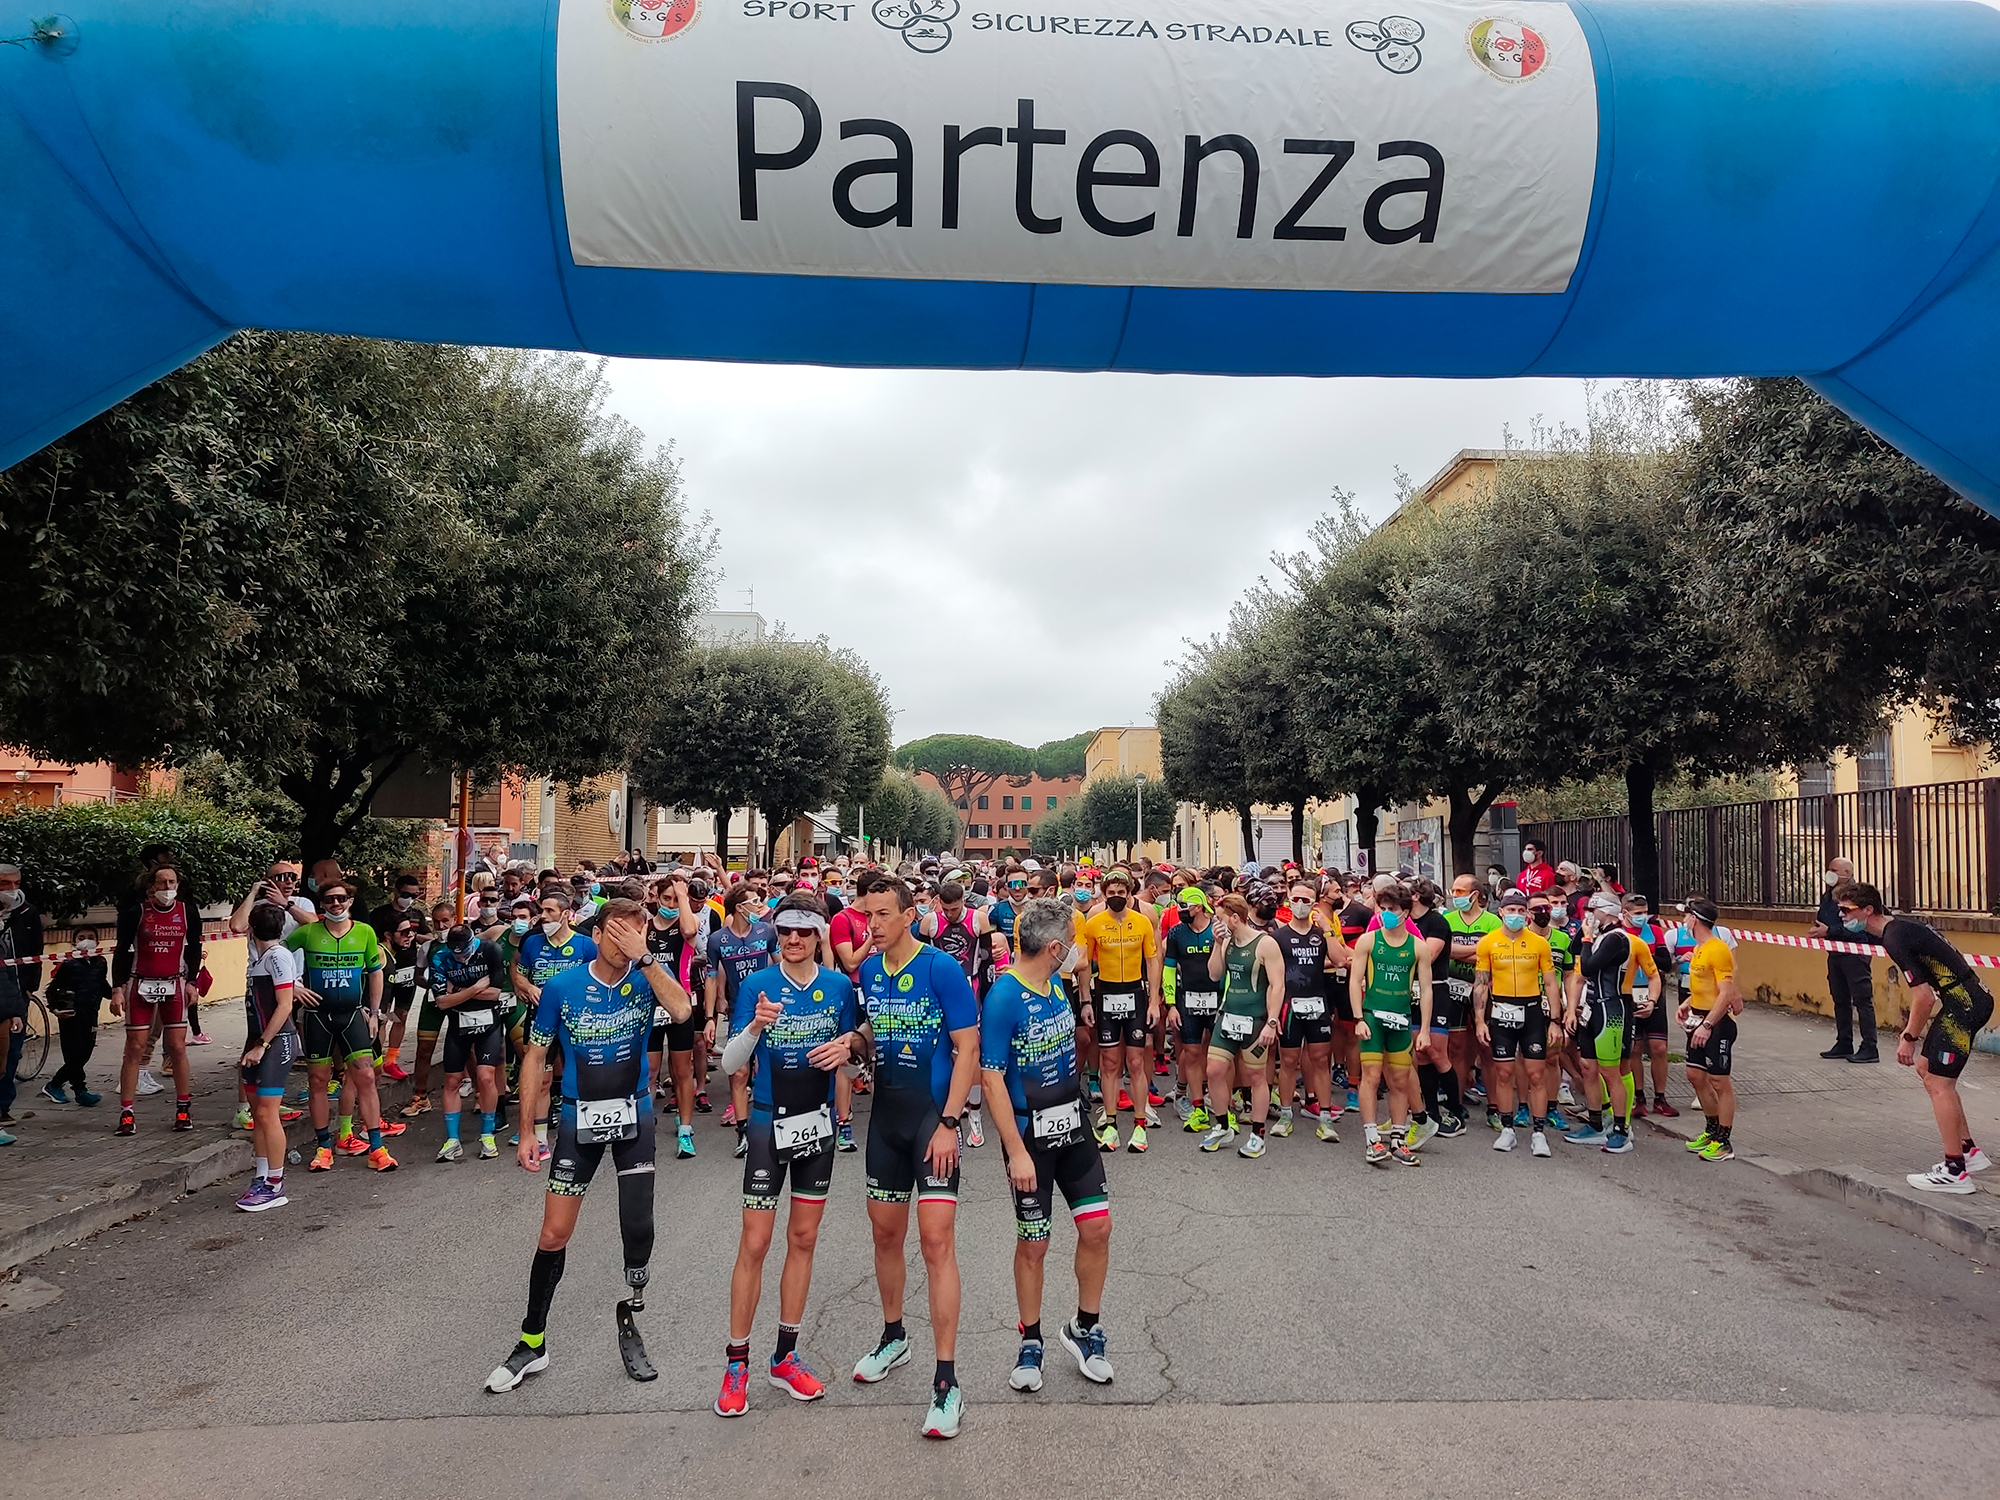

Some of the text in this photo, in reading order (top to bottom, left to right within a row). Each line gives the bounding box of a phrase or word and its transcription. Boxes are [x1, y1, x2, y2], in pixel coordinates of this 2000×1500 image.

[743, 0, 856, 22] SPORT
[971, 12, 1334, 48] SICUREZZA STRADALE
[735, 80, 1447, 245] Partenza
[1291, 947, 1320, 957] MORELLI
[1298, 957, 1314, 965] ITA
[1377, 962, 1386, 971] DE
[739, 968, 754, 979] ITA
[1231, 971, 1241, 980] ITA
[1384, 972, 1401, 982] ITA
[324, 979, 351, 989] ITA
[147, 986, 168, 995] 140
[1111, 1002, 1128, 1012] 122
[1196, 1000, 1207, 1008] 28
[1499, 1010, 1516, 1020] 101
[1231, 1022, 1242, 1031] 14
[592, 1110, 623, 1127] 262
[1046, 1116, 1072, 1134] 263
[790, 1125, 820, 1145] 264
